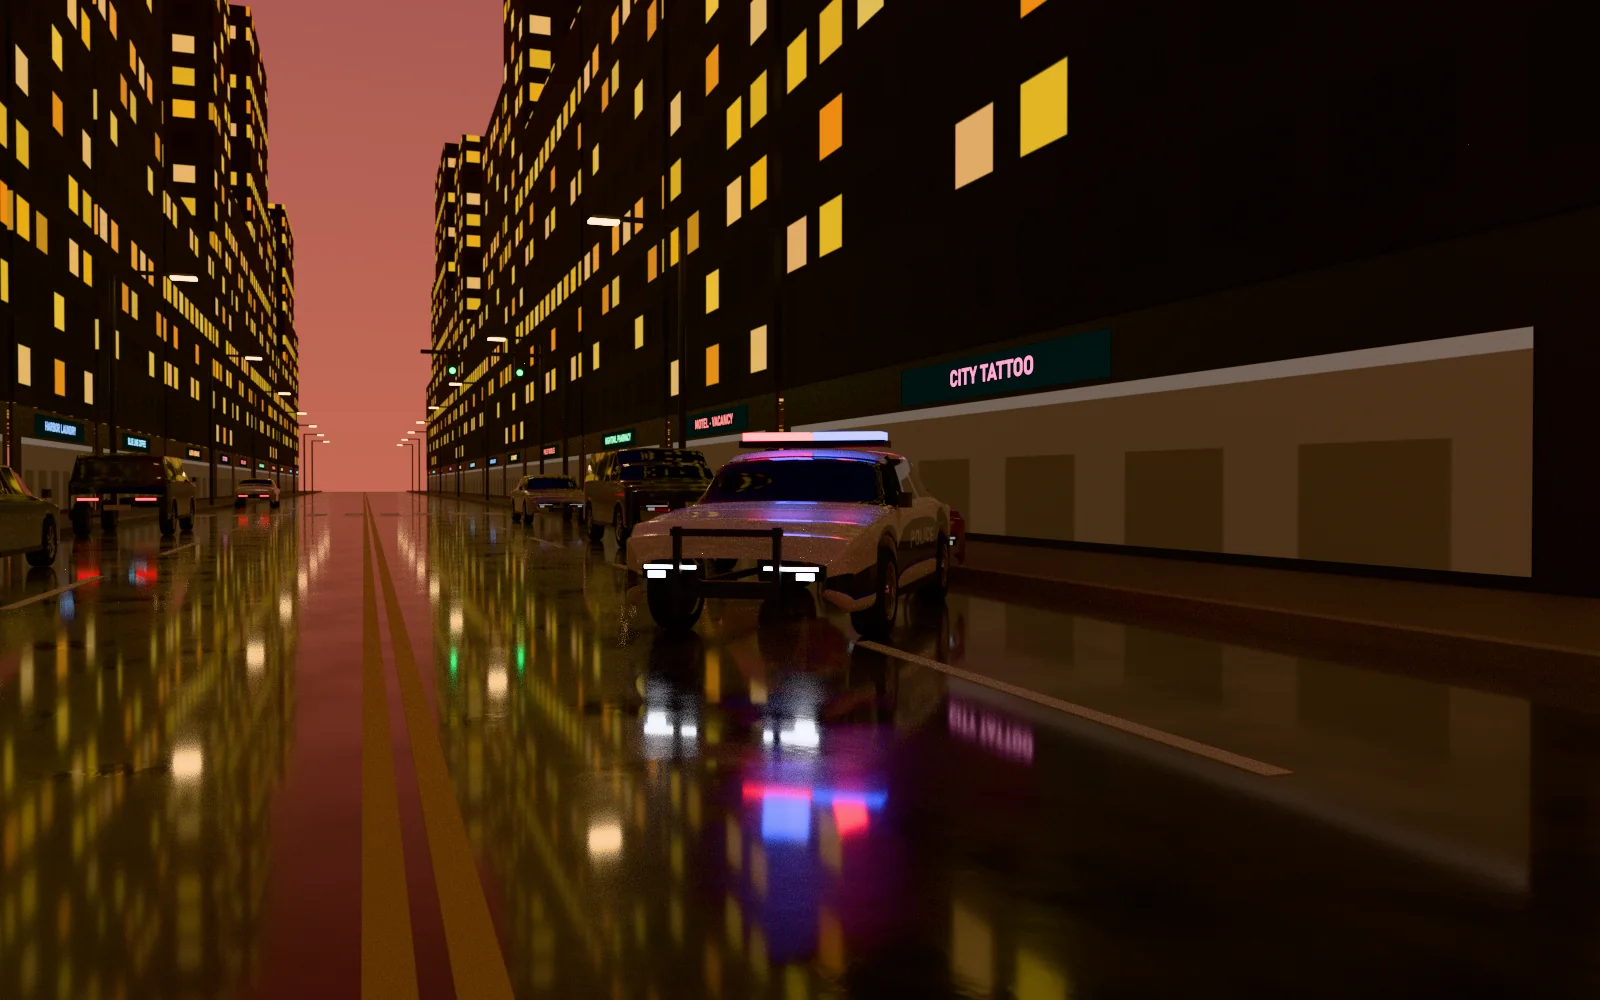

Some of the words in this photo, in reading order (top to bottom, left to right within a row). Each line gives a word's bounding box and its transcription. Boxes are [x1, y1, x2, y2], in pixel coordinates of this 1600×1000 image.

[950, 365, 977, 388] CITY
[980, 354, 1034, 382] TATTOO
[694, 418, 709, 430] MOTEL
[712, 412, 733, 427] VACANCY
[910, 526, 935, 548] POLICE
